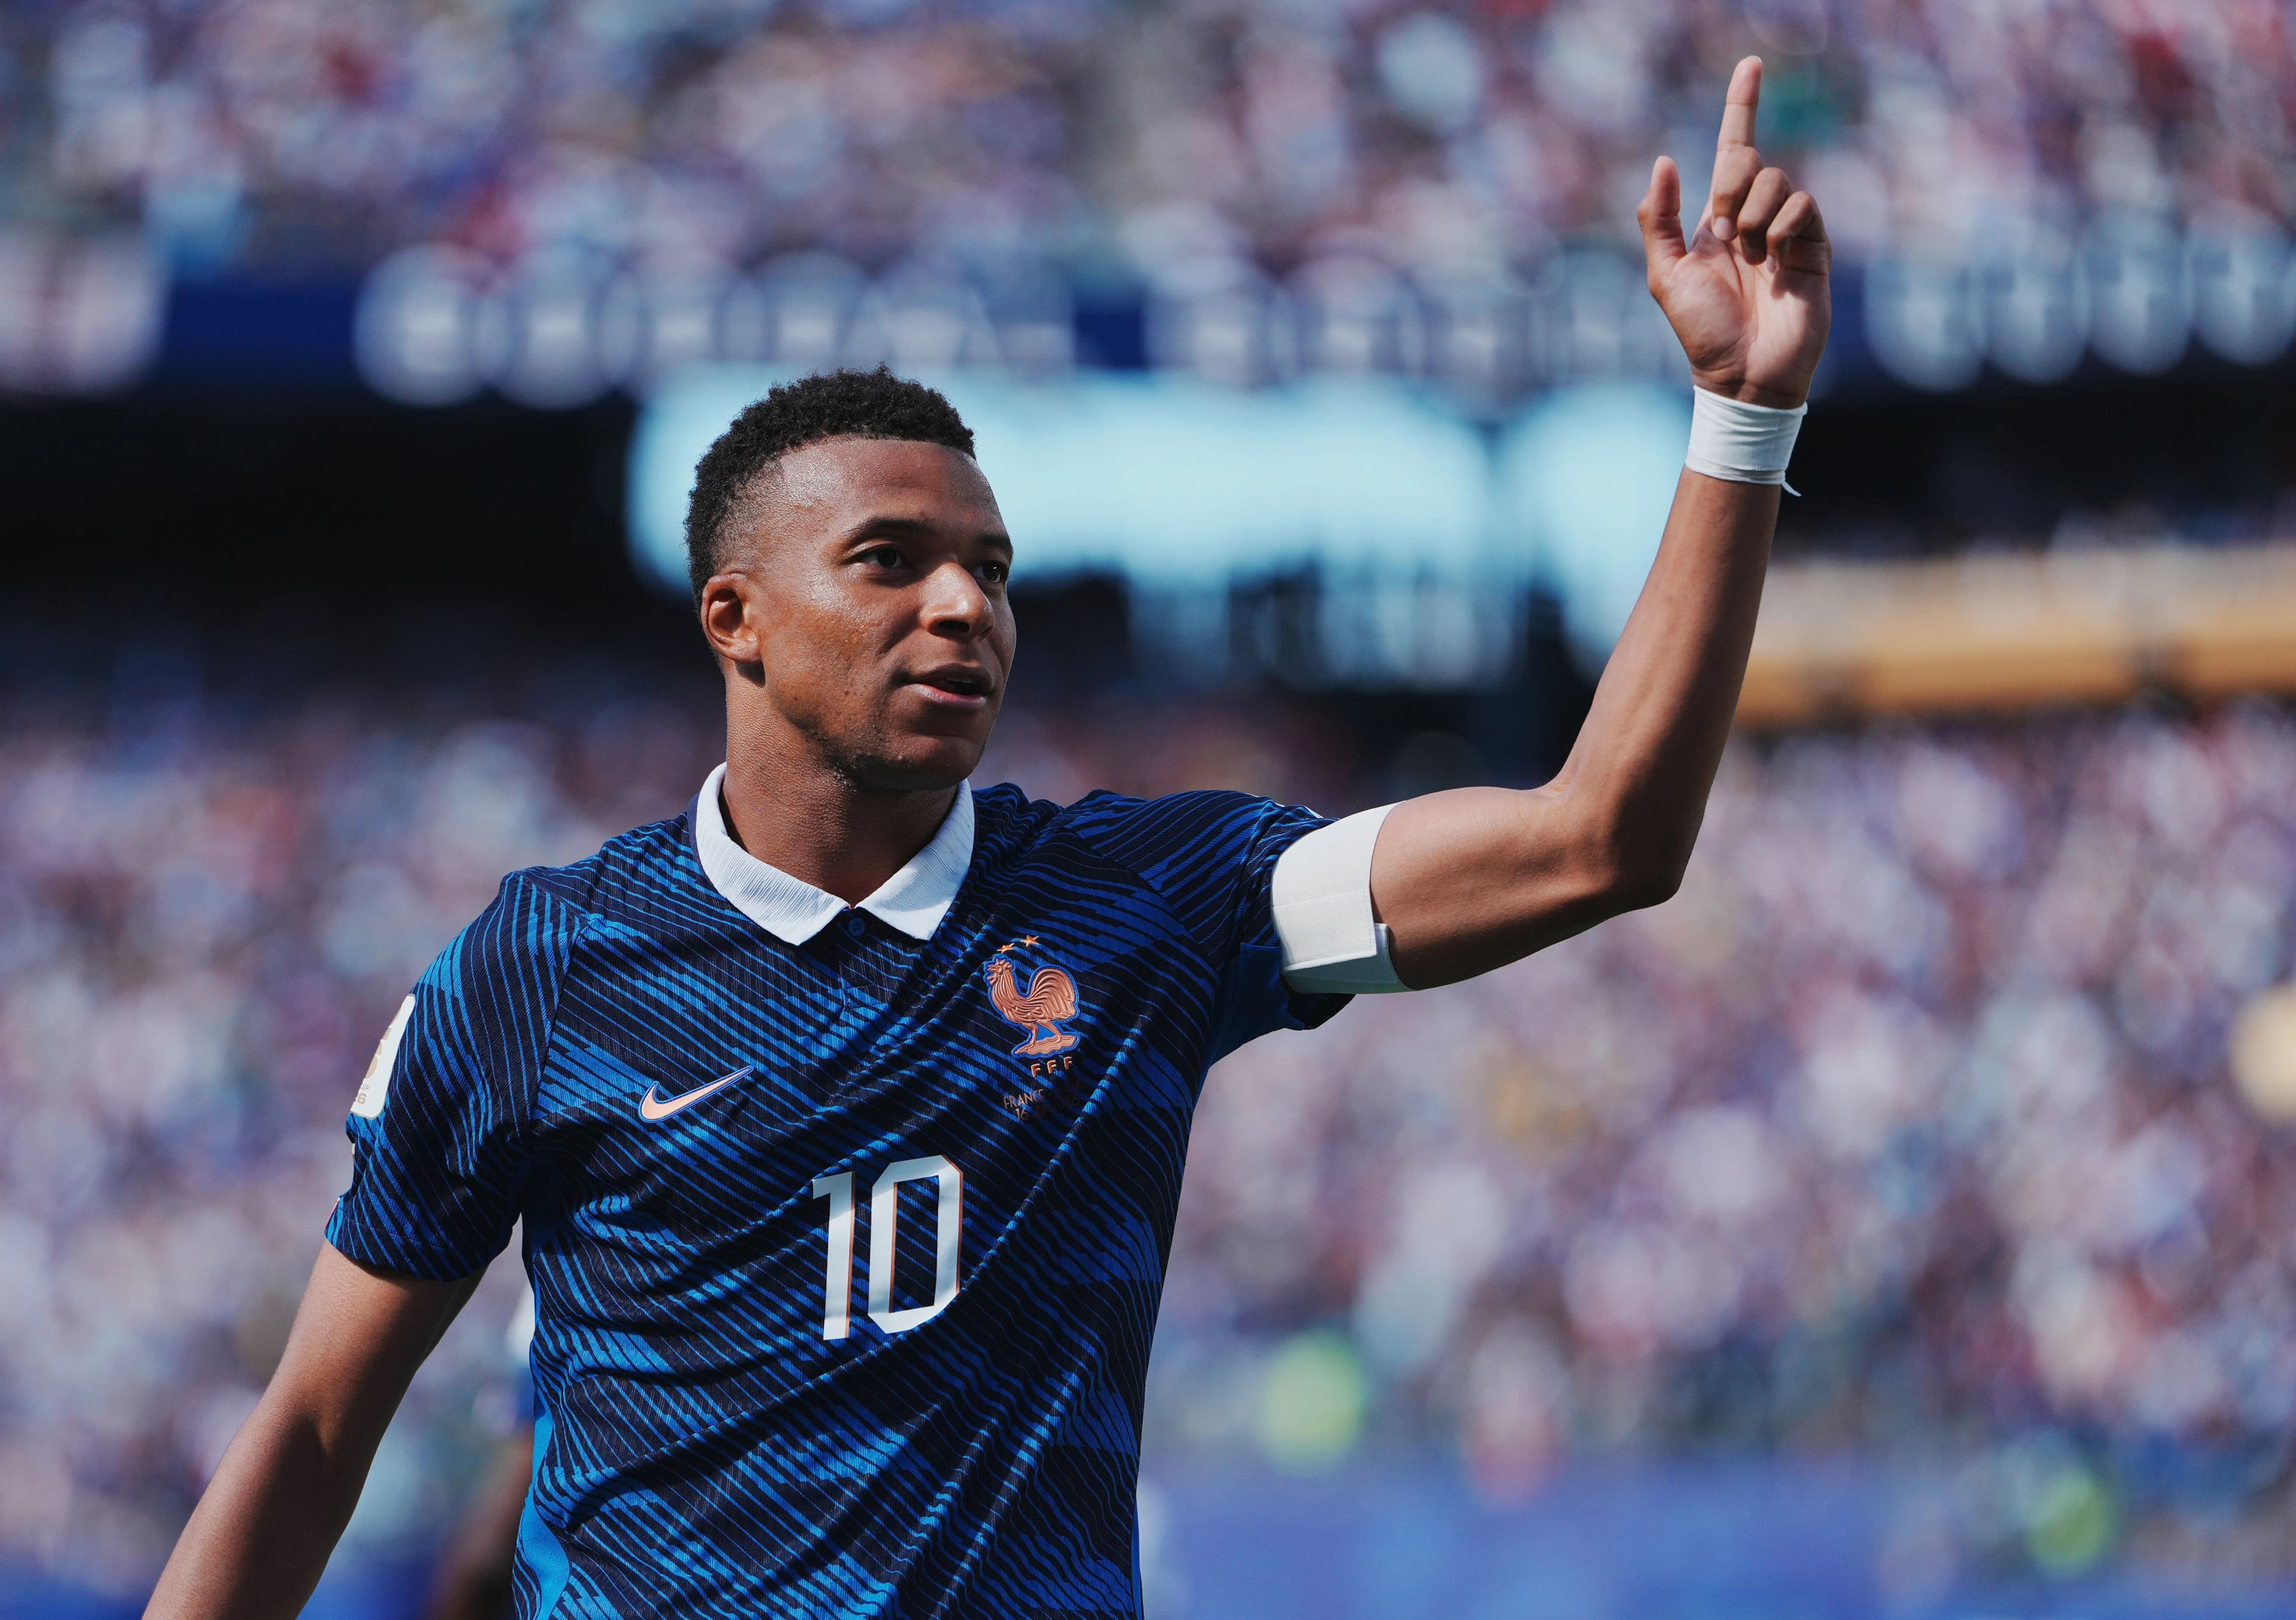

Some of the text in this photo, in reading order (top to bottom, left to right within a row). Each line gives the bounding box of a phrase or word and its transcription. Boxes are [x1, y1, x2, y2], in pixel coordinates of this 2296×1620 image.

[1030, 1056, 1072, 1077] FFF
[1003, 1089, 1044, 1109] FRANCE
[1015, 1108, 1029, 1121] 16
[812, 1154, 963, 1340] 10
